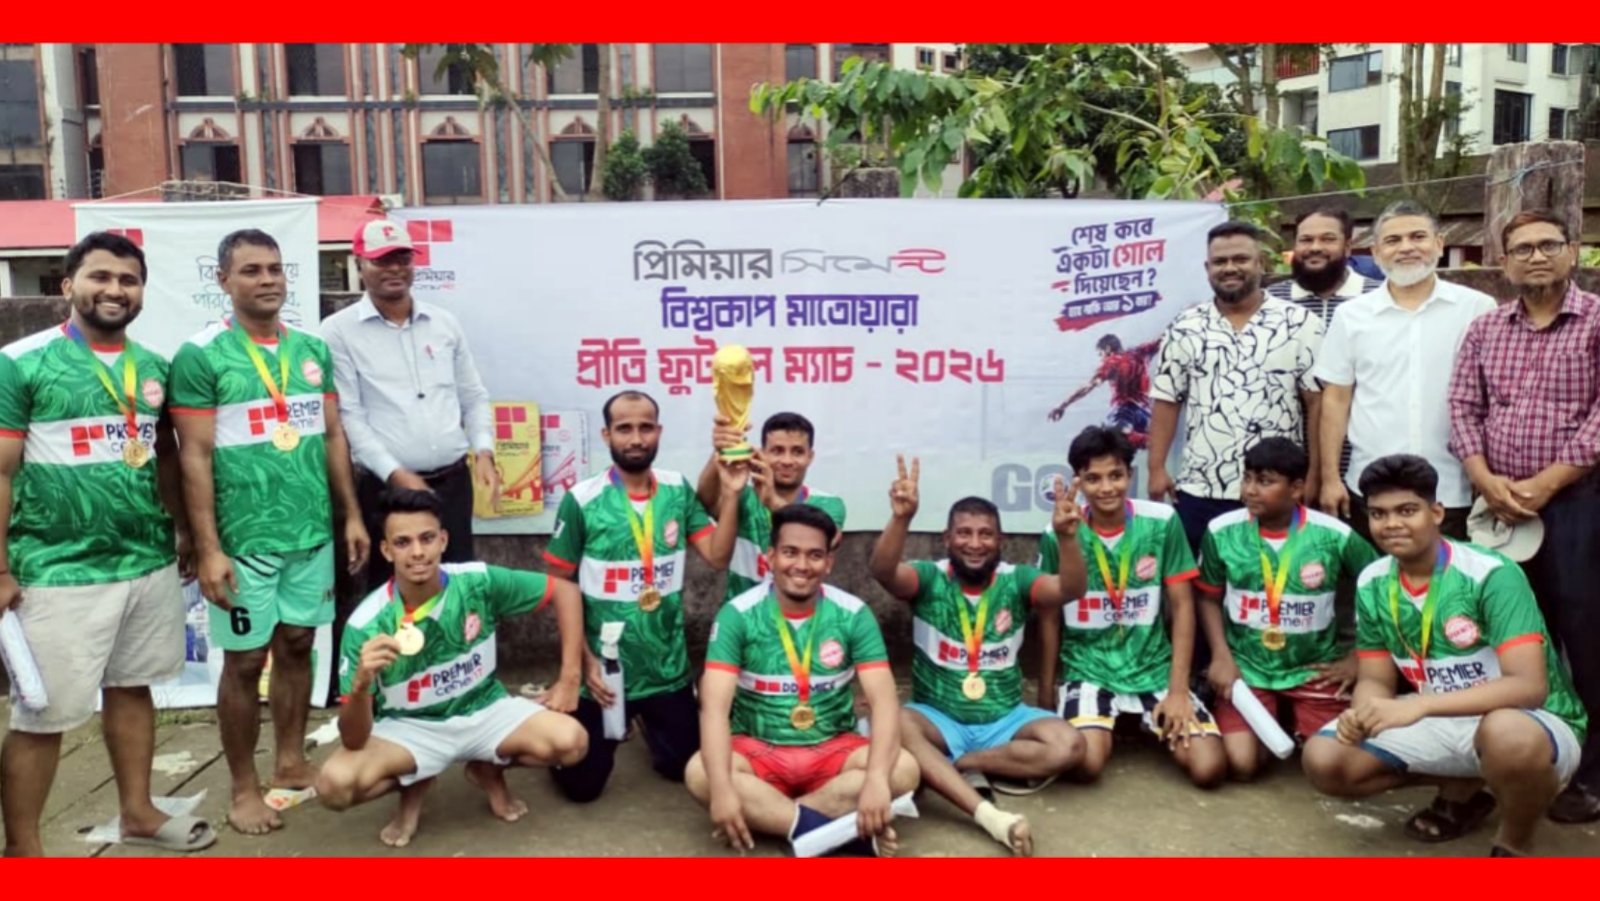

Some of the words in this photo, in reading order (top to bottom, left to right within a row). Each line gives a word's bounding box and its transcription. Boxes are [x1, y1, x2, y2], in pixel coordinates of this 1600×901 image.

[1072, 224, 1107, 245] শেষ
[1114, 218, 1153, 239] কবে
[633, 239, 773, 280] প্রিমিয়ার
[781, 249, 946, 274] সিমেন্ট
[1052, 245, 1109, 273] একটা
[1113, 240, 1165, 268] গোল
[661, 287, 776, 331] বিশ্বকাপ
[786, 294, 919, 334] মাতোয়ারা
[576, 338, 647, 388] প্রীতি
[657, 335, 773, 395] ফুটল
[783, 346, 854, 383] ম্যাচ
[895, 348, 1004, 384] ২০২৬
[230, 606, 251, 635] 6
